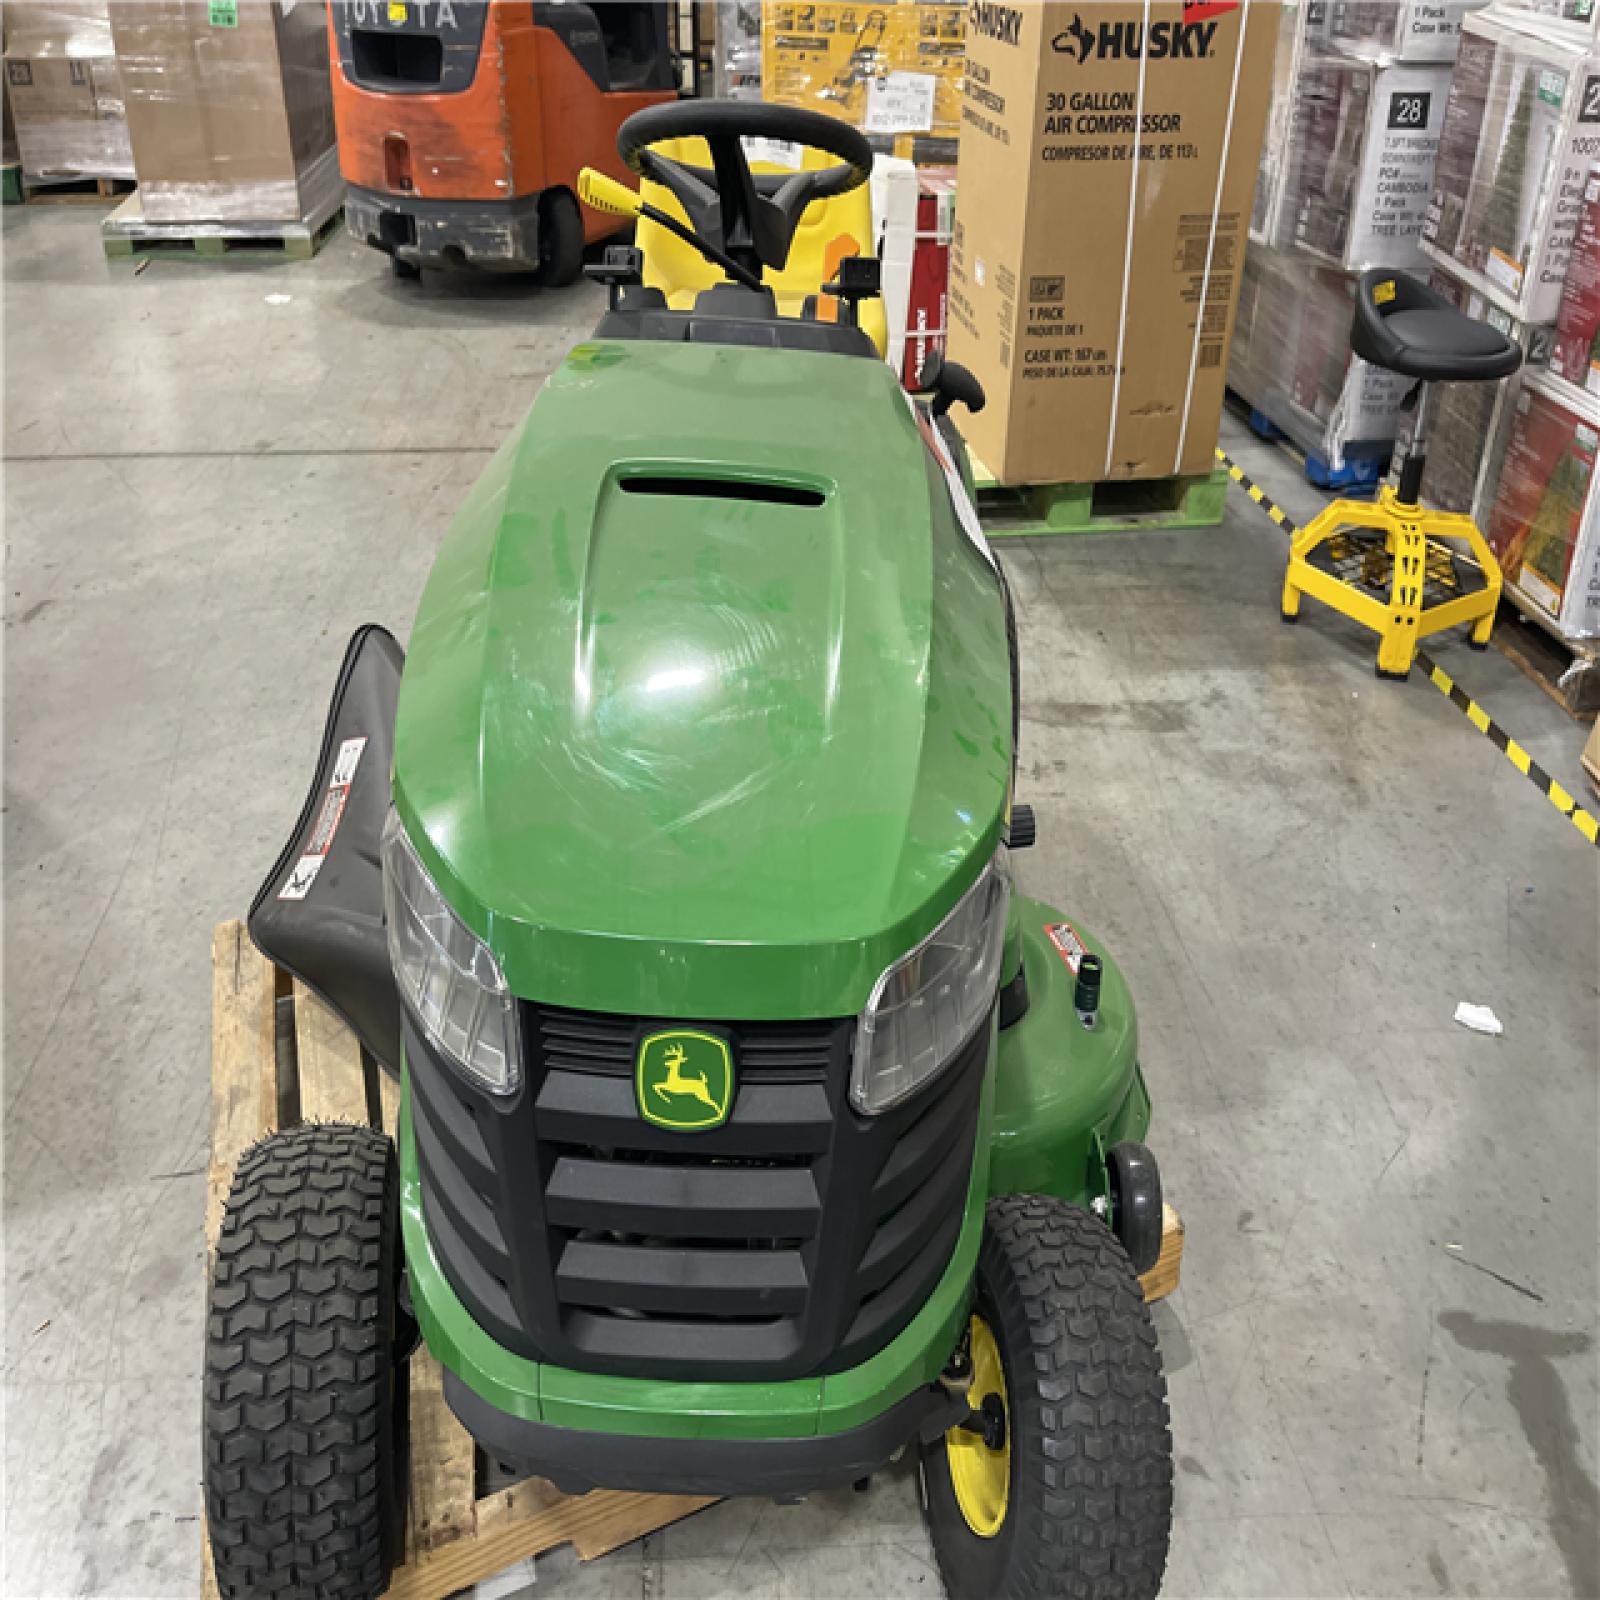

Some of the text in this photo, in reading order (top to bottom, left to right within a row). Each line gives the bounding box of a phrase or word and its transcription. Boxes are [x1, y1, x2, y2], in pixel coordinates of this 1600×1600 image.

[1096, 22, 1218, 58] HUSKY
[1045, 92, 1136, 111] 30 GALLON
[1396, 97, 1421, 123] 28
[1044, 115, 1072, 134] AIR
[1112, 145, 1127, 160] DE
[1024, 349, 1051, 363] CASE
